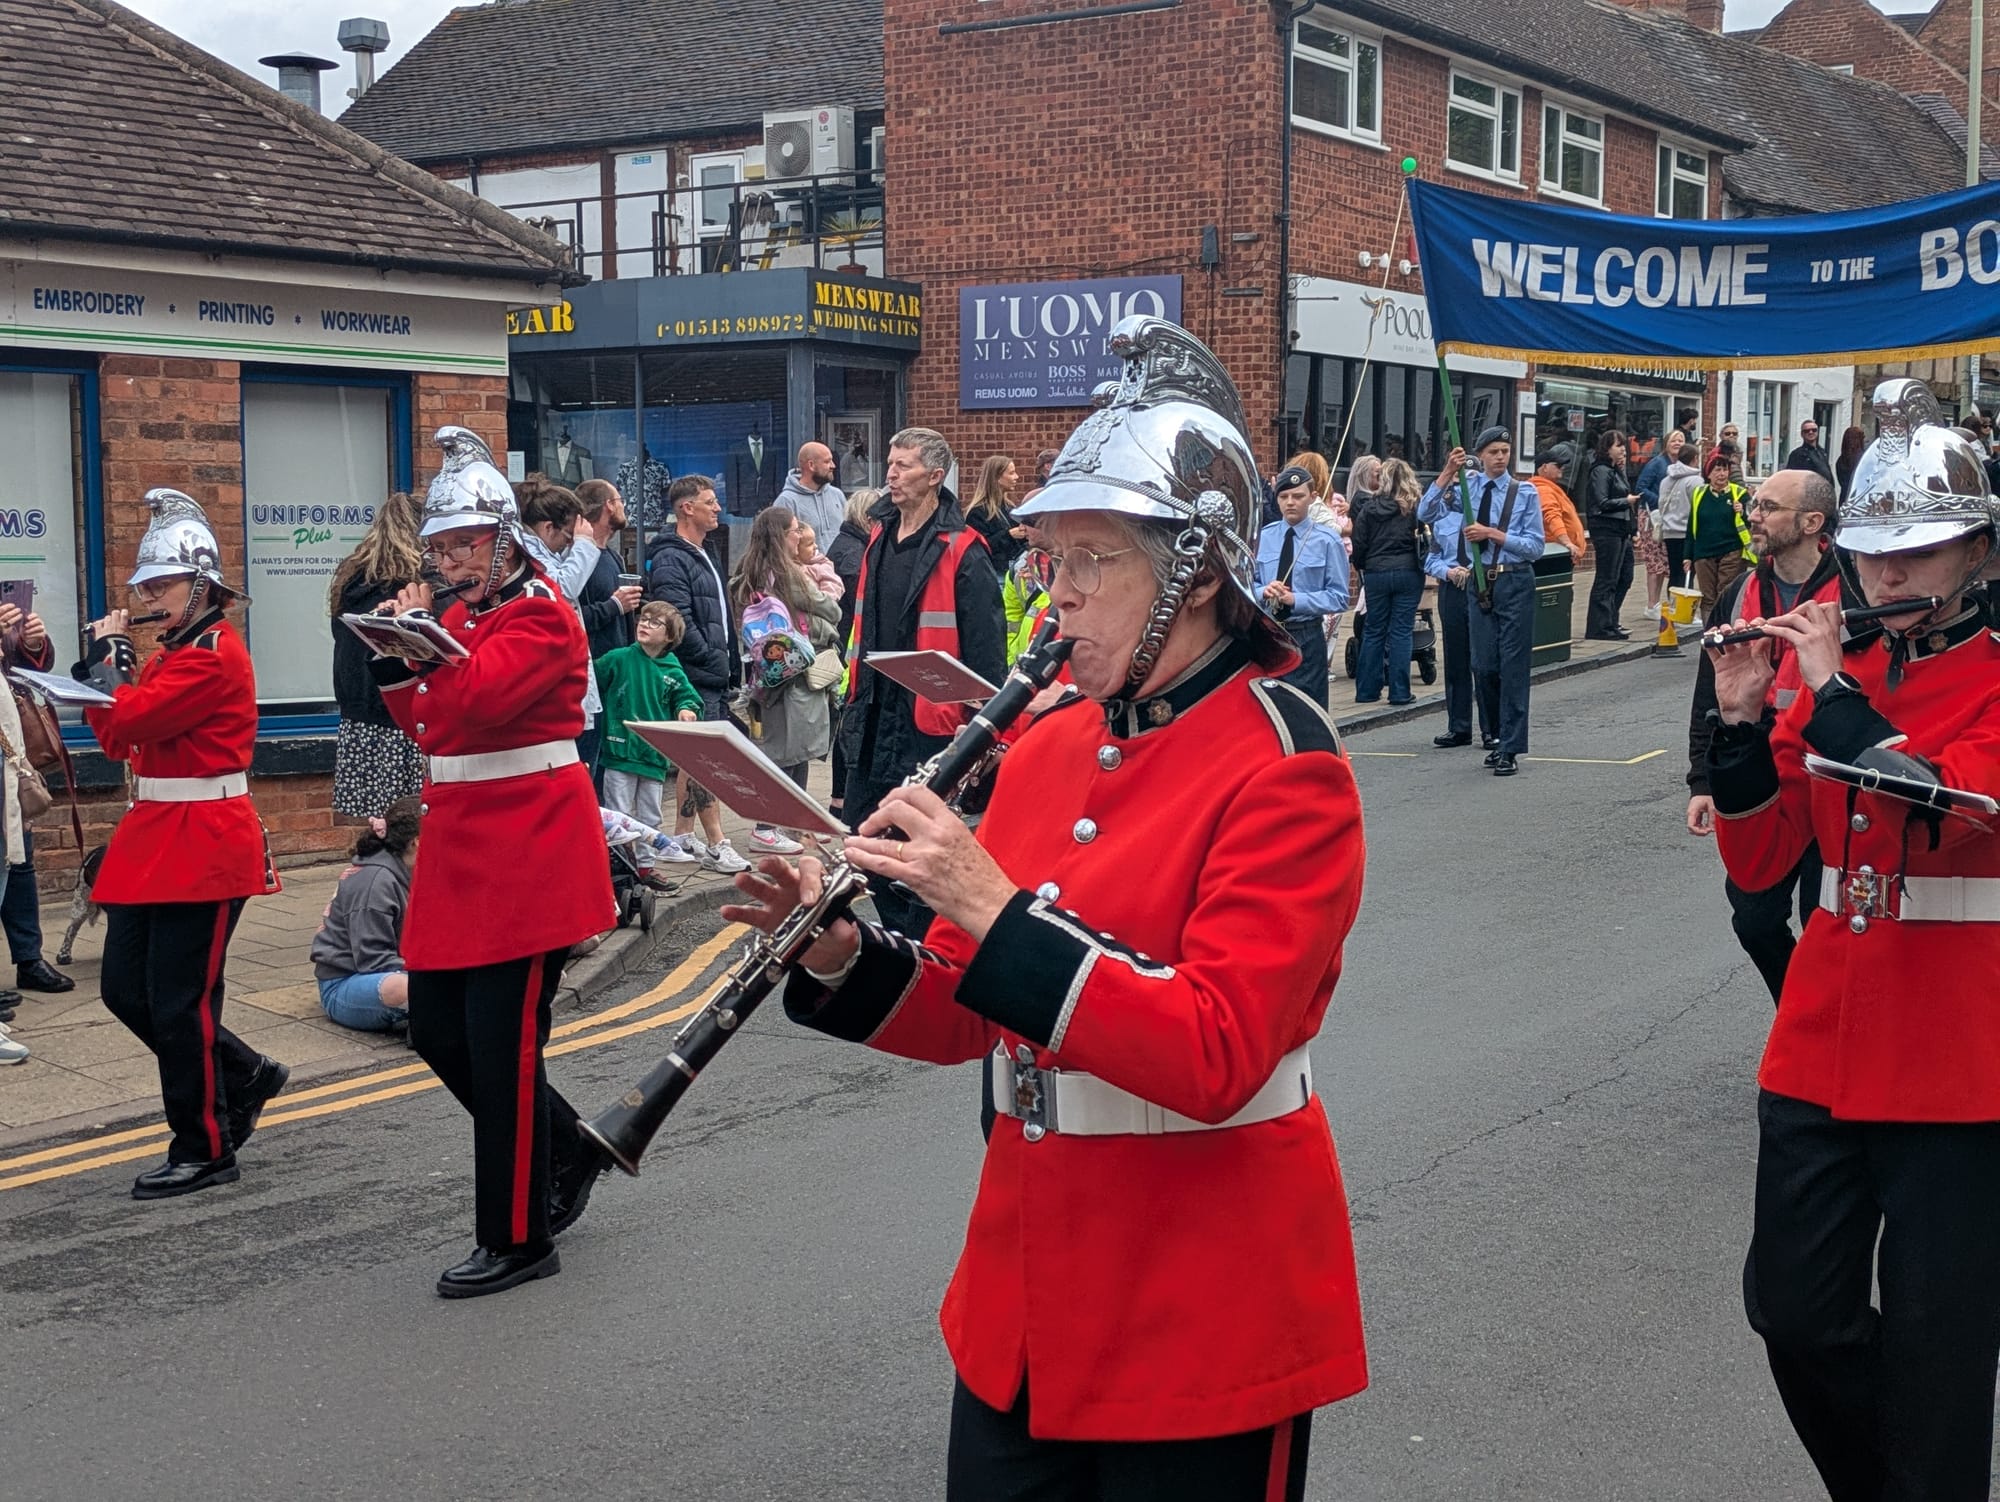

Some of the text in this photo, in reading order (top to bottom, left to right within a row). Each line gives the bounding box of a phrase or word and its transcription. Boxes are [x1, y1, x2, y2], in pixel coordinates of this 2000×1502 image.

[1472, 220, 2000, 308] WELCOME TO THE BO
[33, 287, 410, 335] EMBROIDERY PRINTING WORKWEAR
[815, 281, 921, 318] MENSWEAR
[675, 318, 731, 338] 01543
[735, 314, 804, 334] 898972
[813, 309, 919, 337] WEDDING SUITS
[974, 371, 1004, 381] CASUAL
[1048, 364, 1086, 378] BOSS
[975, 387, 1038, 399] REMUS UOMO
[252, 504, 376, 525] UNIFORMS
[293, 527, 333, 550] Plus
[285, 557, 305, 565] OPEN
[306, 557, 319, 565] FOR
